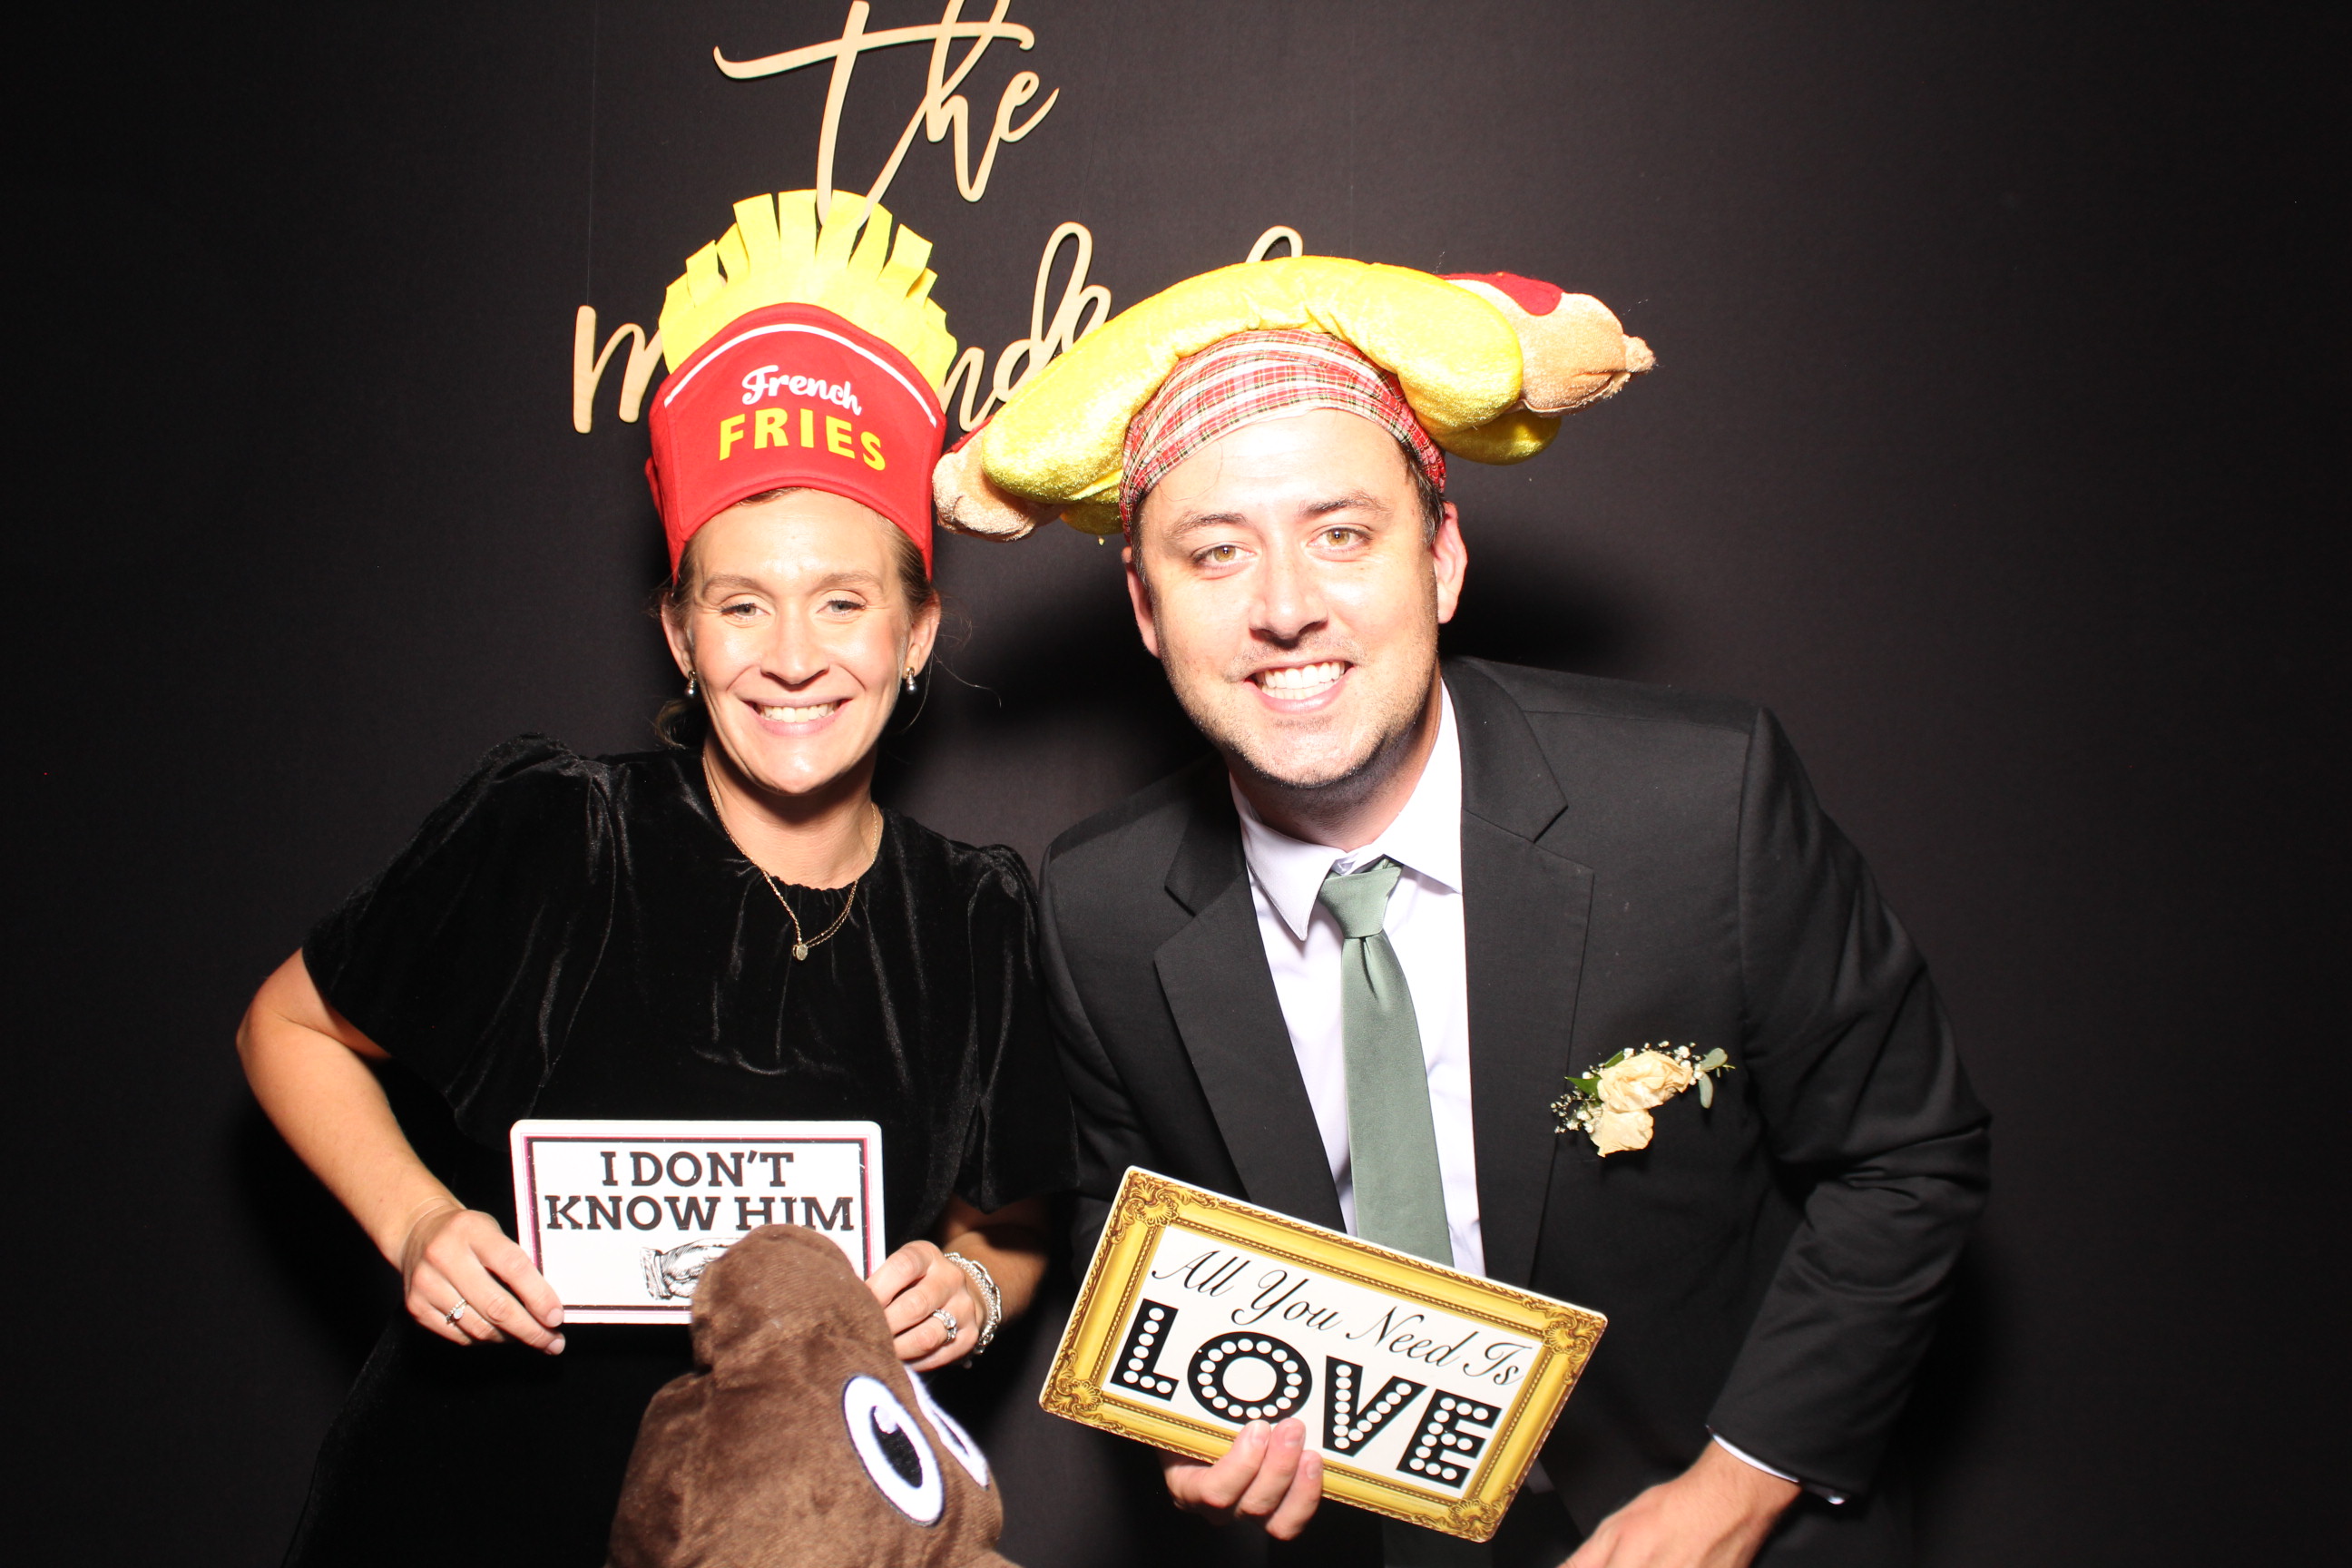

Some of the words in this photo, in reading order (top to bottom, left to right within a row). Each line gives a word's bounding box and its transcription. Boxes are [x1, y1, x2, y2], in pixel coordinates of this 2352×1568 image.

[712, 0, 1060, 229] the
[741, 365, 862, 416] French
[720, 407, 886, 471] FRIES
[600, 1151, 619, 1187] I
[630, 1150, 794, 1188] DON'T
[544, 1195, 721, 1230] KNOW
[734, 1196, 855, 1231] HIM
[1152, 1250, 1249, 1298] All
[1231, 1269, 1344, 1330] You
[1346, 1305, 1478, 1368] Need
[1463, 1339, 1533, 1386] Is
[1110, 1298, 1504, 1491] LOVE
